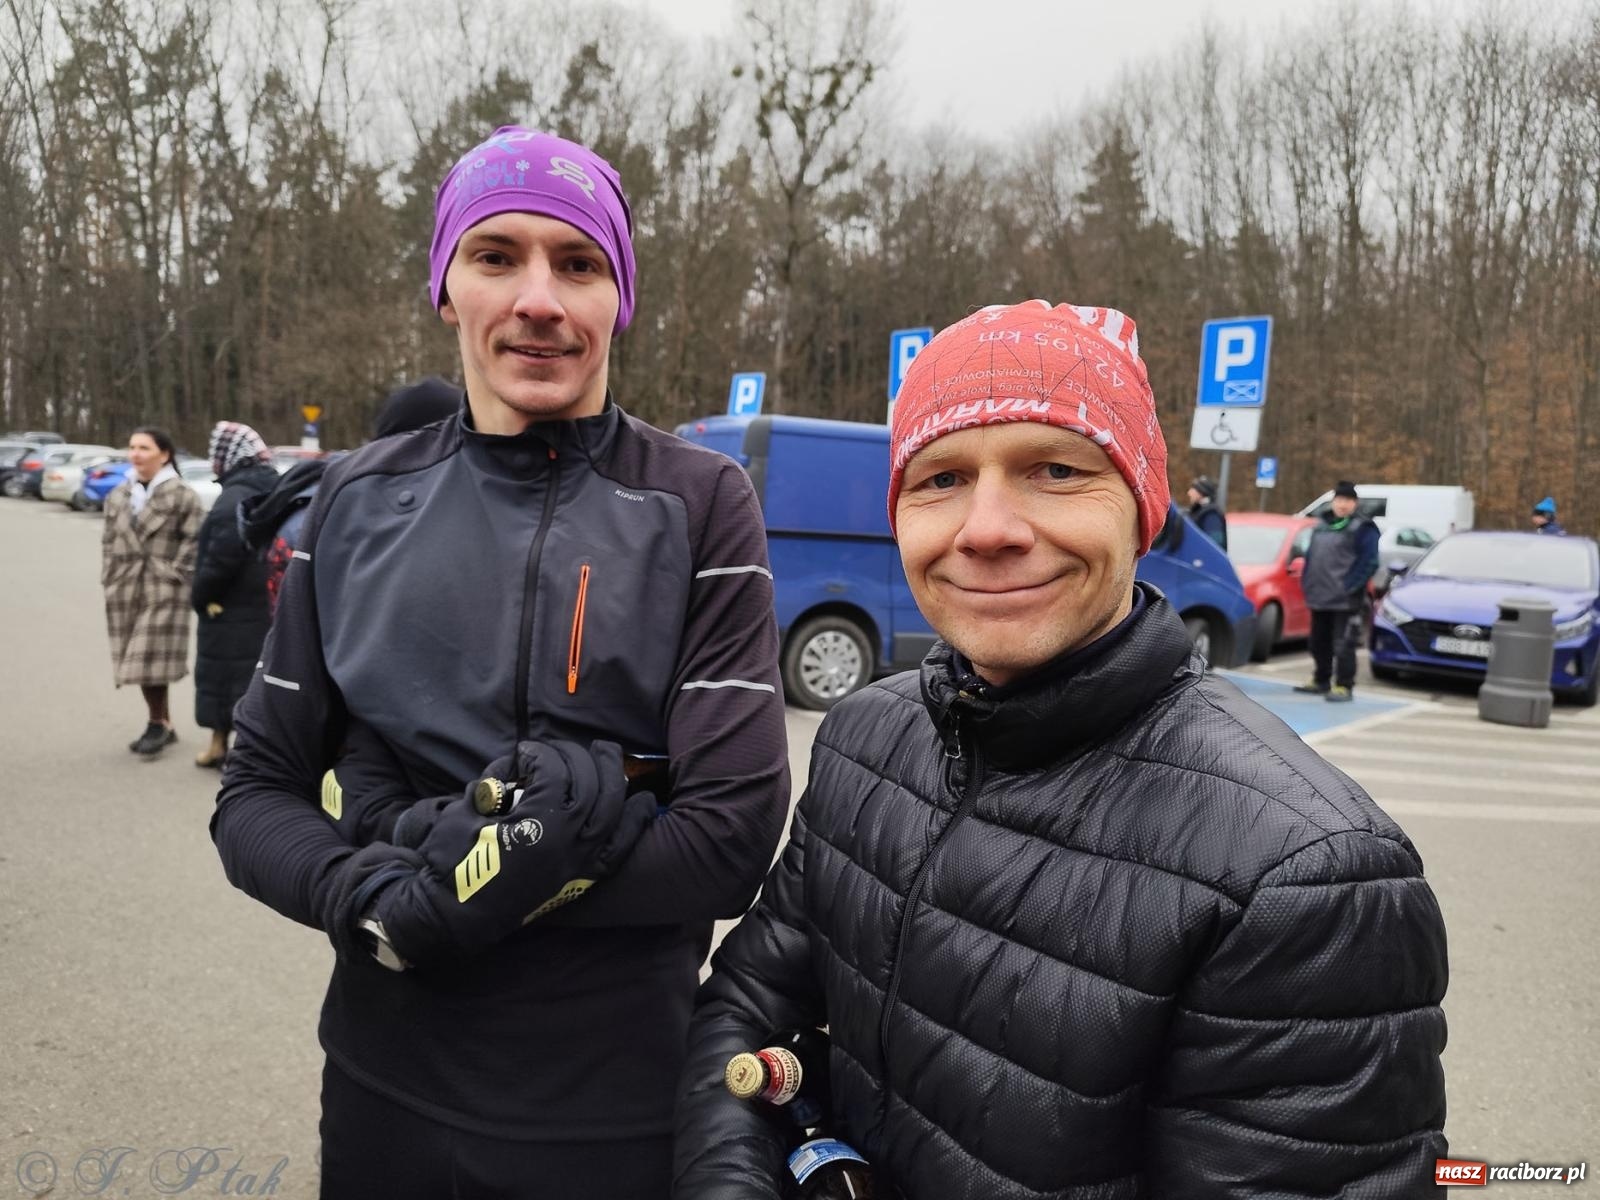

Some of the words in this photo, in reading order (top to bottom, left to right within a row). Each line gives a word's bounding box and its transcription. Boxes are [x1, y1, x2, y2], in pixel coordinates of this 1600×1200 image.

[979, 330, 1022, 344] km
[899, 336, 924, 380] P
[1215, 326, 1257, 382] P
[943, 369, 1043, 388] SIEMIANOWICE
[733, 378, 758, 414] P
[615, 489, 645, 502] KIPRUN
